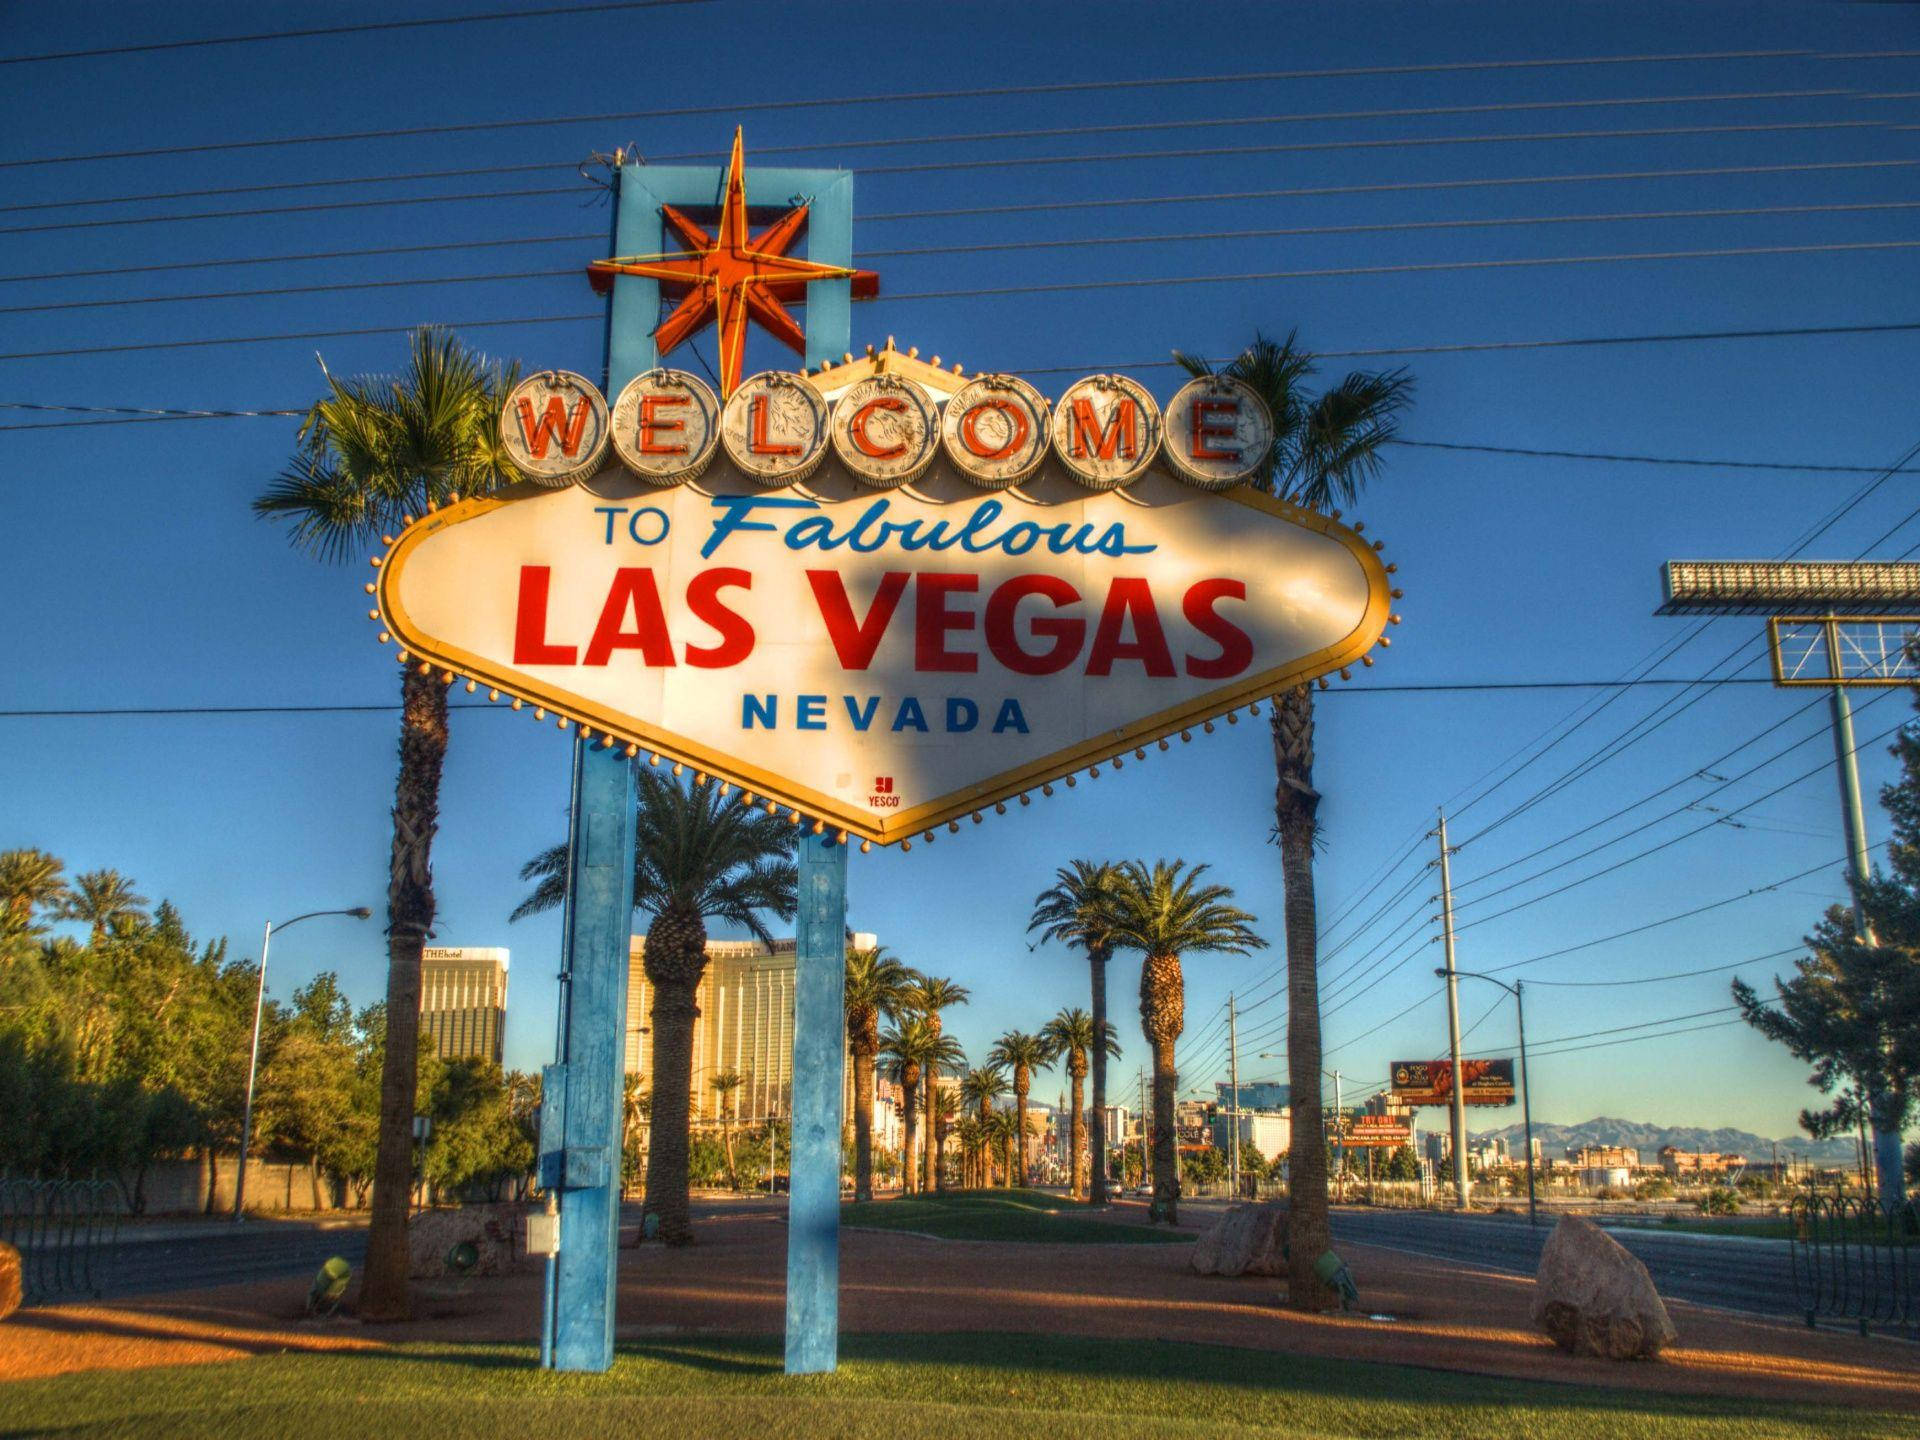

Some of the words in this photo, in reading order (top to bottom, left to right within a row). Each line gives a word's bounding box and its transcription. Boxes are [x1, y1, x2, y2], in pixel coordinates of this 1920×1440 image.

[517, 395, 1239, 461] WELCOME
[594, 507, 670, 545] TO
[701, 495, 1158, 559] Fabulous
[513, 565, 756, 669] LAS
[805, 569, 1255, 679] VEGAS
[742, 694, 1030, 734] NEVADA
[869, 796, 899, 807] YESCO
[424, 949, 462, 958] THEhotel
